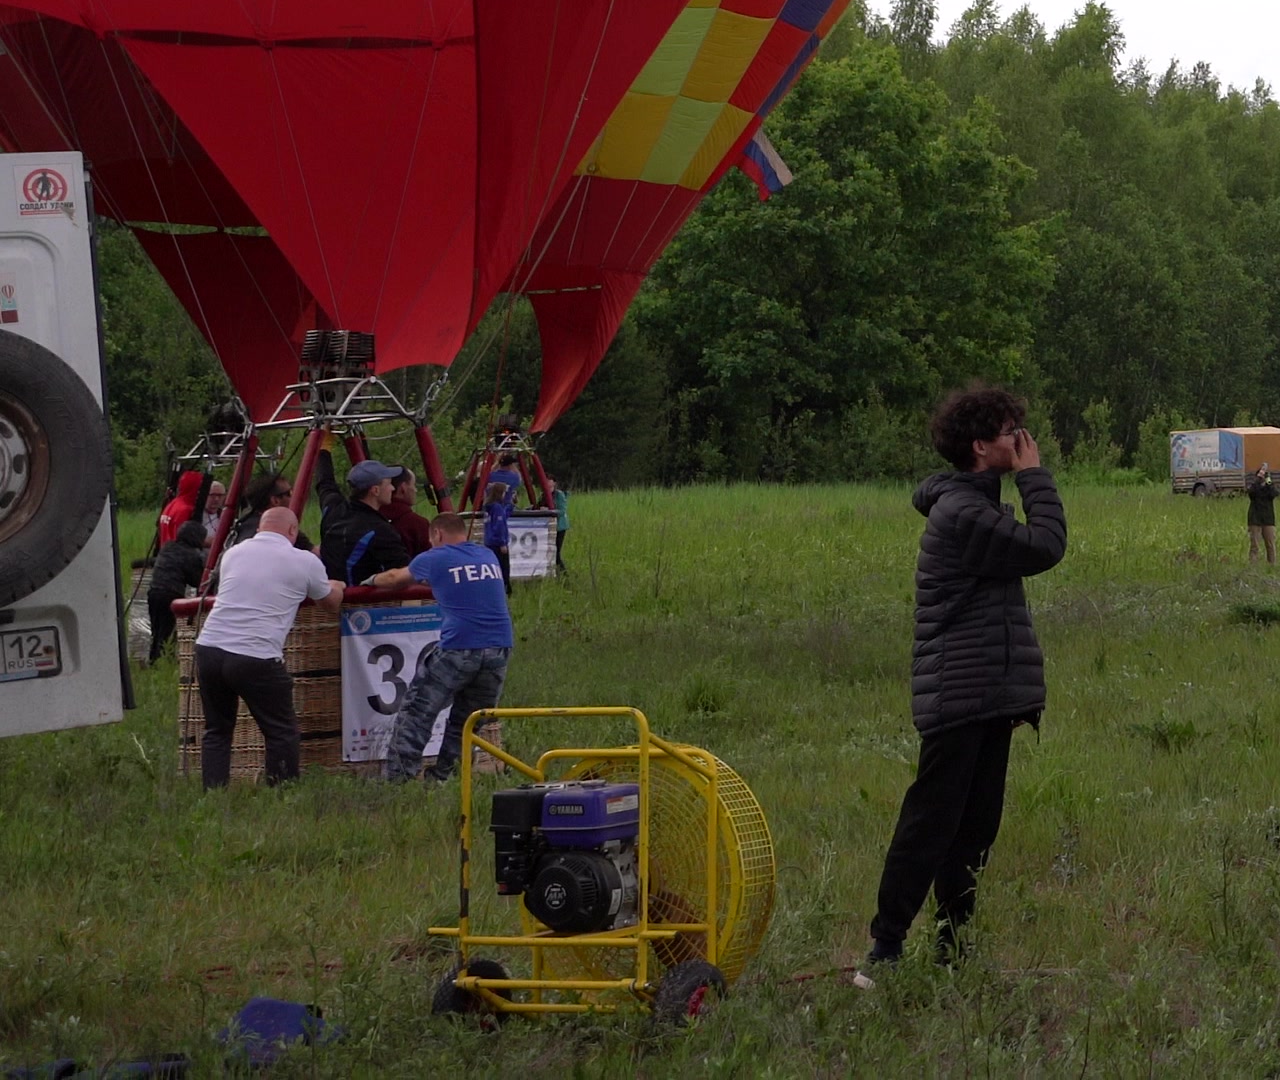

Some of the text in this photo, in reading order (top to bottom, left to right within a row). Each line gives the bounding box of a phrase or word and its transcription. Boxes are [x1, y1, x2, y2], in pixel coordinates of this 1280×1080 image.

[20, 202, 48, 211] СОЛДАТ
[10, 635, 43, 659] 12
[8, 659, 33, 669] RUS
[557, 805, 584, 814] YAMAHA
